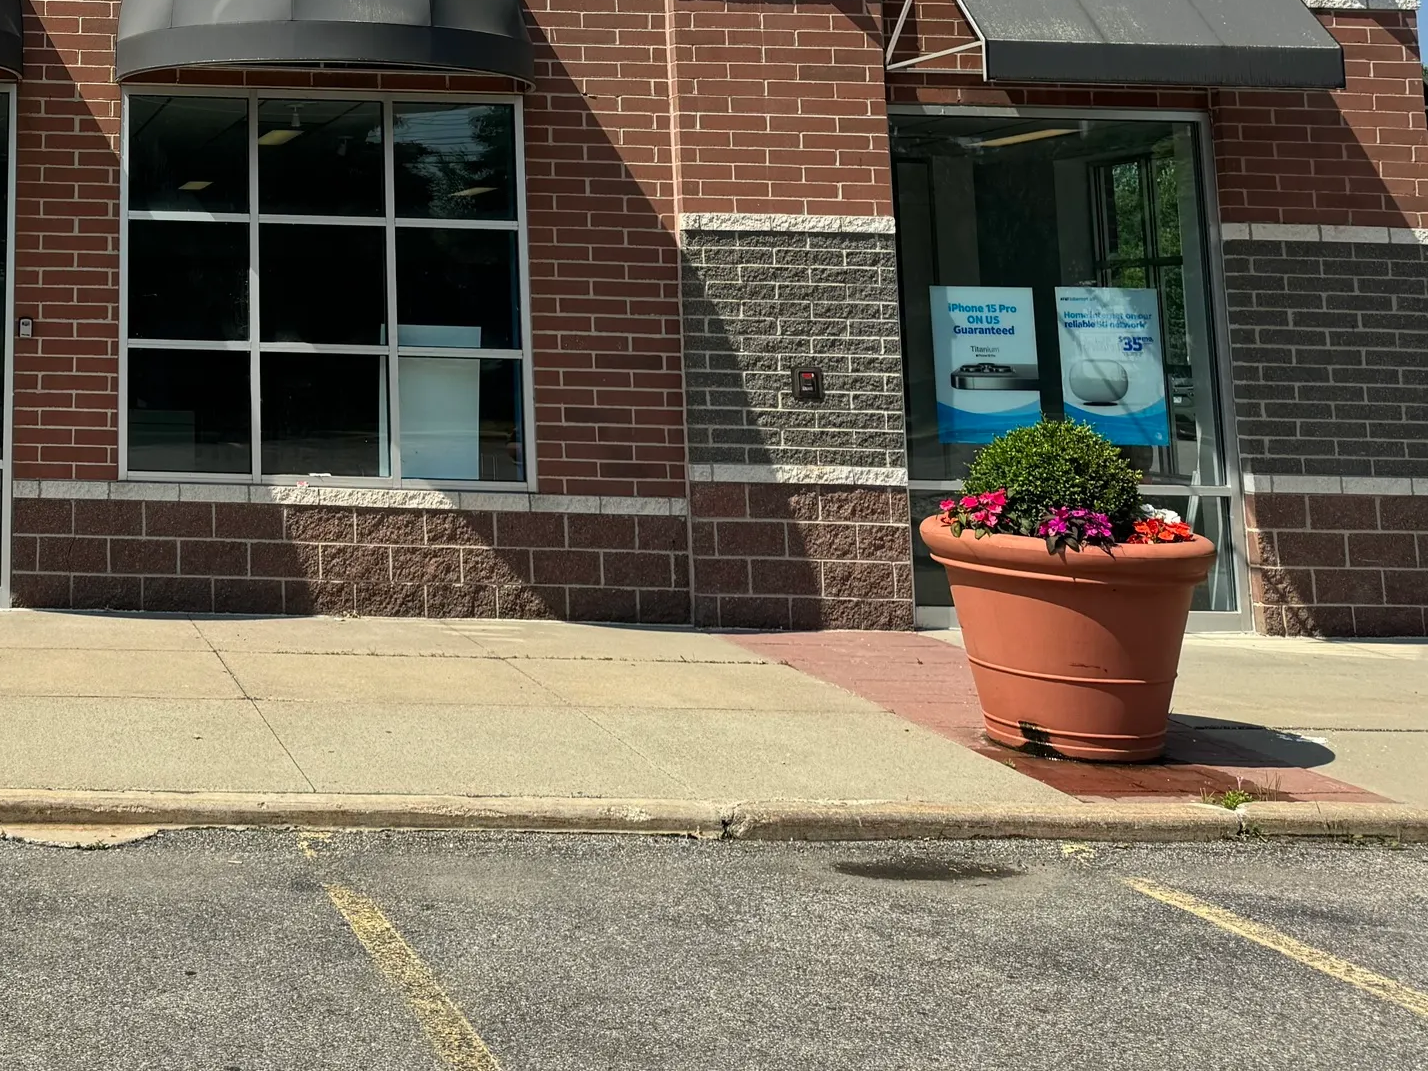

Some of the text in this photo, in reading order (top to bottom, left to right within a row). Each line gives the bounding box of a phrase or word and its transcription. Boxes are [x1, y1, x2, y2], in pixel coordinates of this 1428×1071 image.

[947, 302, 1017, 313] iPhone 15 Pro
[967, 315, 1000, 324] ON US
[1064, 320, 1096, 328] reliable
[953, 325, 1015, 335] Guaranteed
[970, 345, 1000, 353] Titanium
